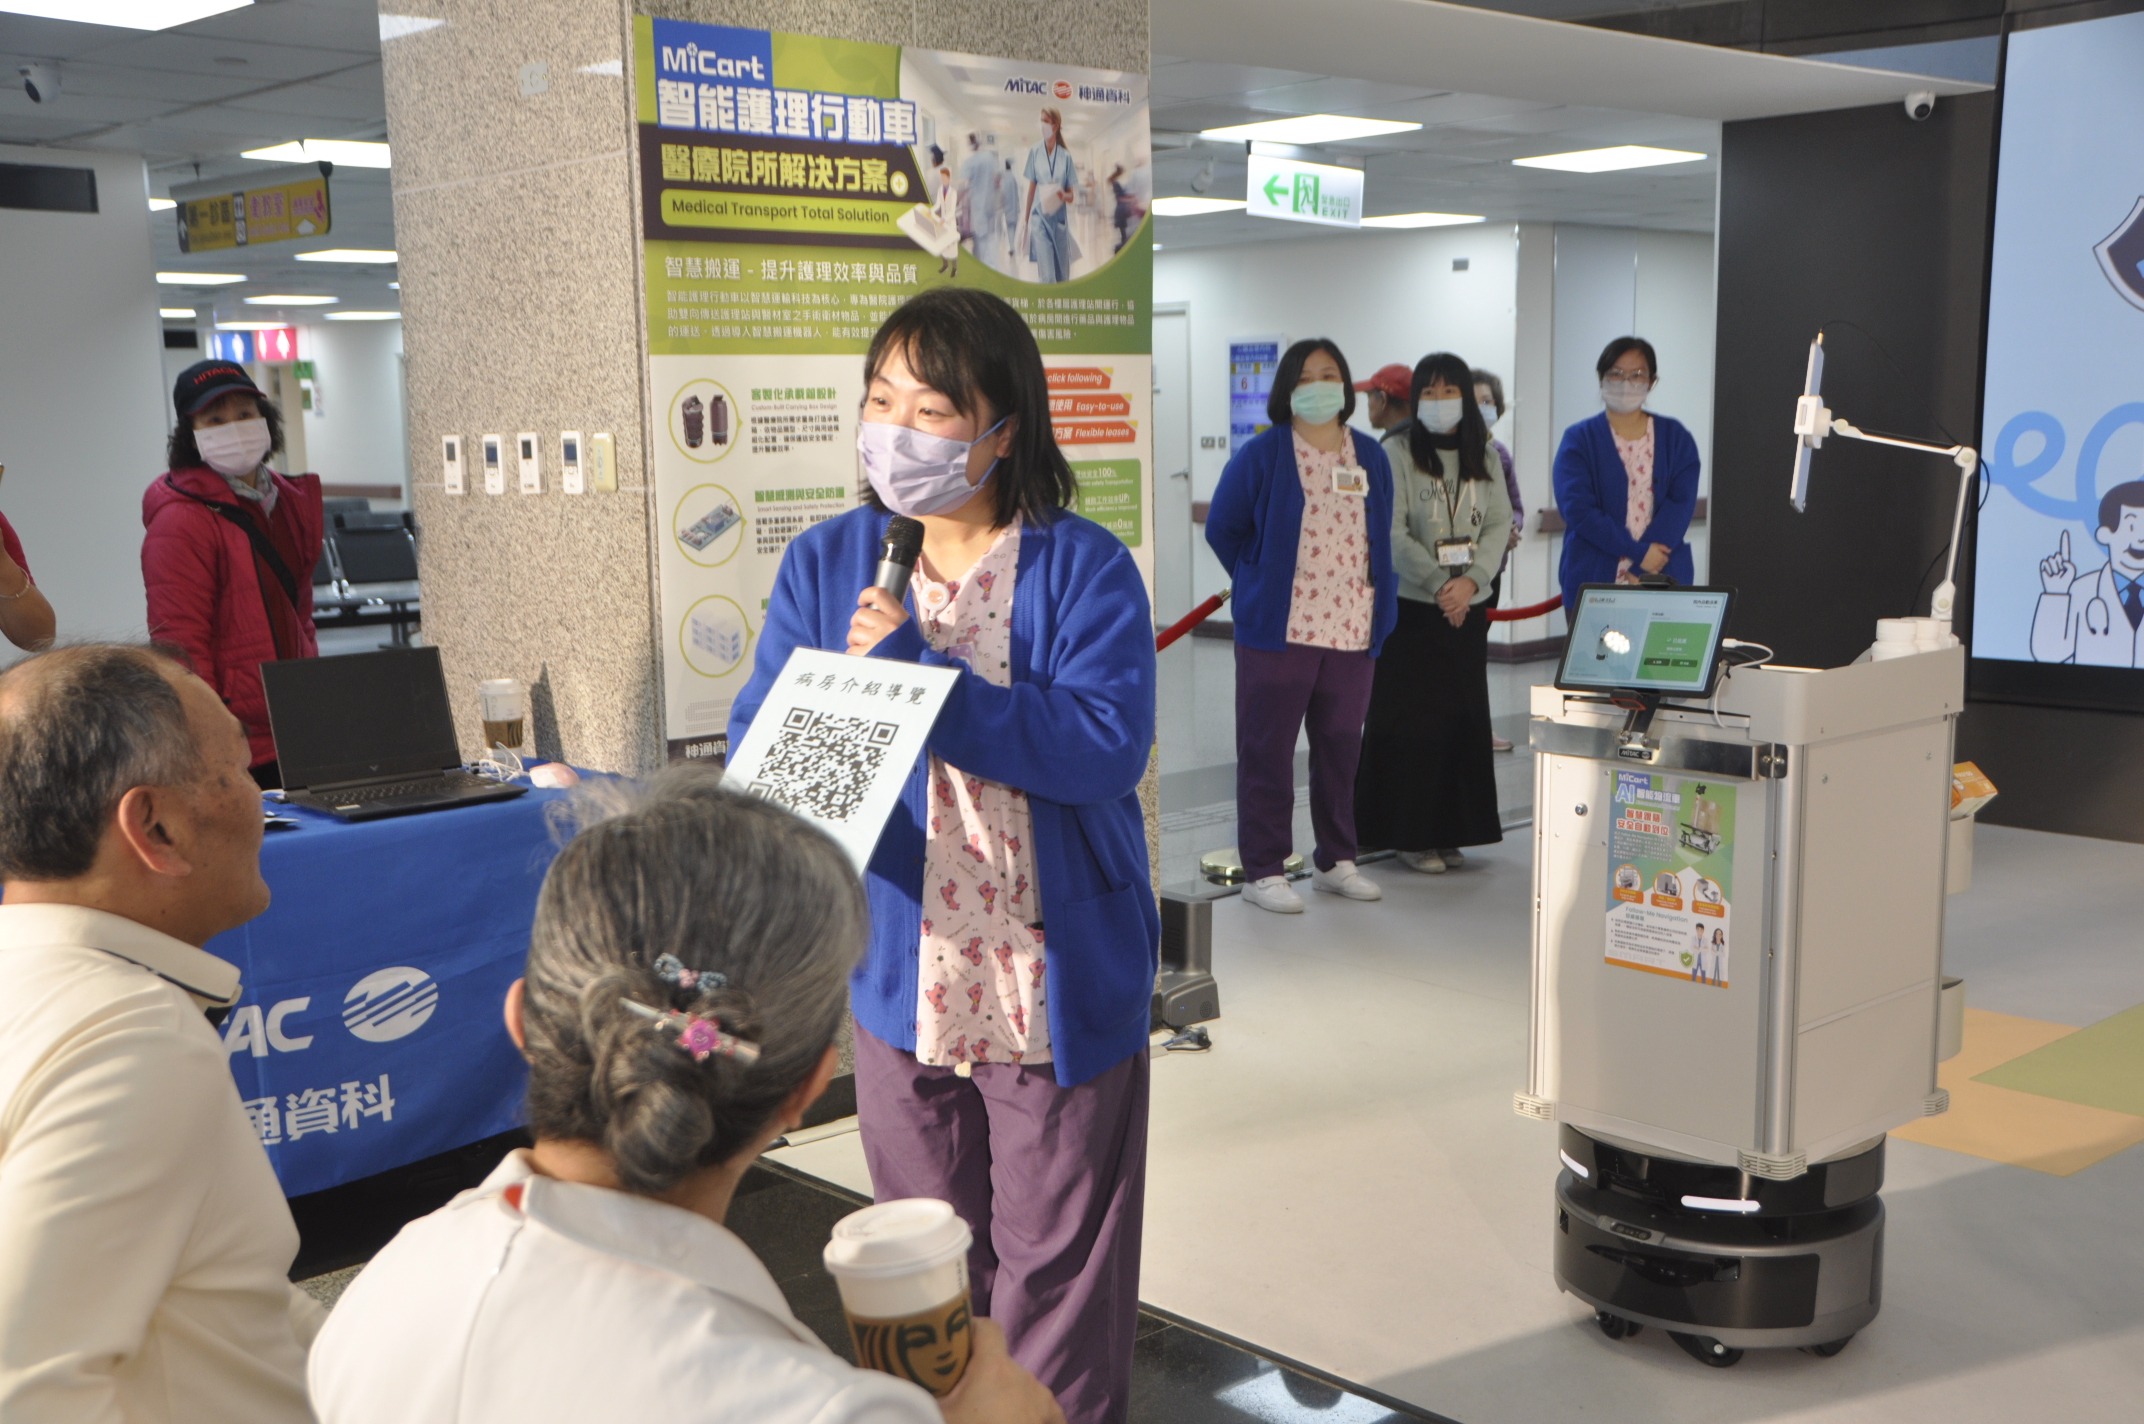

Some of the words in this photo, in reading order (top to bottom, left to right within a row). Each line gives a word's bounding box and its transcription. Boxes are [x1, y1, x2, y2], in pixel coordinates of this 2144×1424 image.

[662, 42, 765, 80] MiCart
[1079, 85, 1130, 104] 神通資科
[658, 79, 917, 145] 智能護理行動車
[673, 200, 728, 215] Medical
[732, 202, 798, 221] Transport
[802, 206, 834, 219] Total
[838, 208, 890, 222] Solution
[1322, 207, 1349, 219] EXIT
[665, 256, 741, 280] 智慧搬運
[761, 259, 918, 284] 提升護理效率與品質
[1048, 373, 1066, 383] click
[1068, 373, 1102, 385] following
[1241, 377, 1248, 391] 6
[1076, 402, 1124, 414] Easy-to-use
[1053, 427, 1073, 440] 方案
[1075, 428, 1105, 438] Flexible
[1106, 427, 1130, 437] leases
[795, 672, 927, 705] 病房介紹導覽
[685, 740, 729, 759] 神通資
[1619, 773, 1649, 784] MiCart
[1615, 783, 1635, 804] AI
[220, 996, 314, 1058] AC
